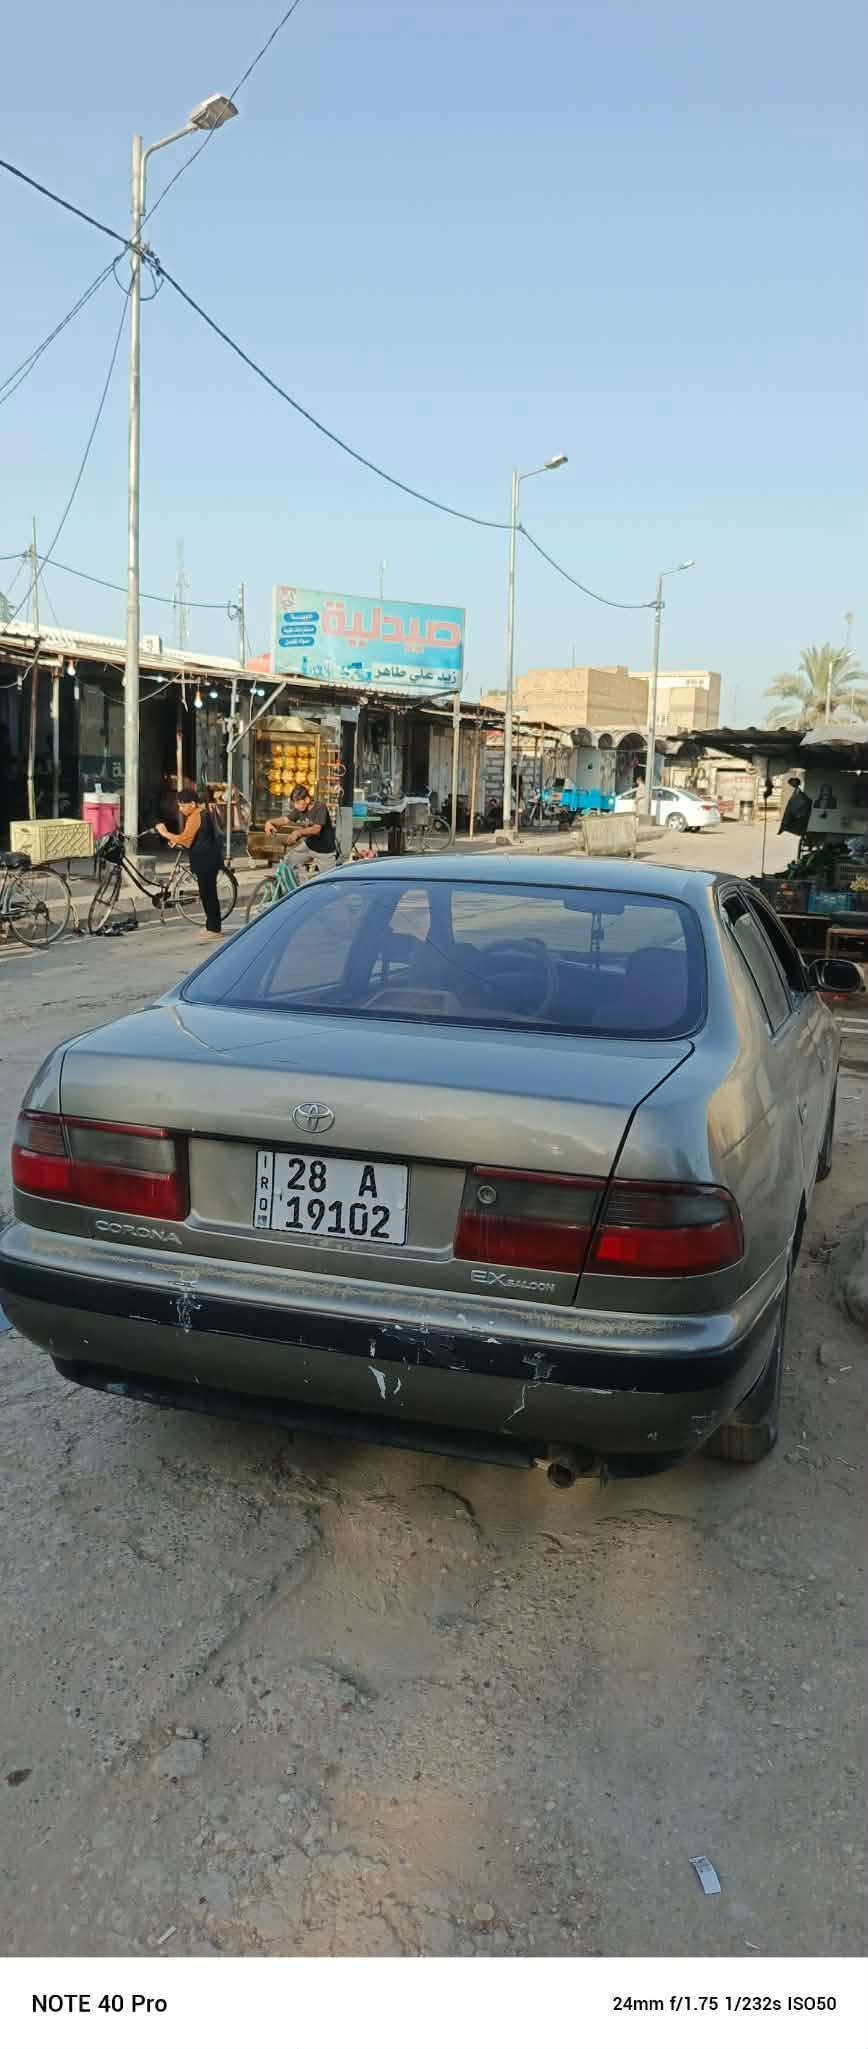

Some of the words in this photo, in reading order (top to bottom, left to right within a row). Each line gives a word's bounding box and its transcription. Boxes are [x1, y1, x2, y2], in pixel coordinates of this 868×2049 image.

[322, 601, 460, 653] صيدلية
[375, 666, 407, 678] طاهر
[287, 1158, 327, 1192] 28
[358, 1165, 378, 1198] A
[96, 1220, 183, 1246] CORONA
[286, 1196, 390, 1239] 19102
[471, 1270, 505, 1287] EX
